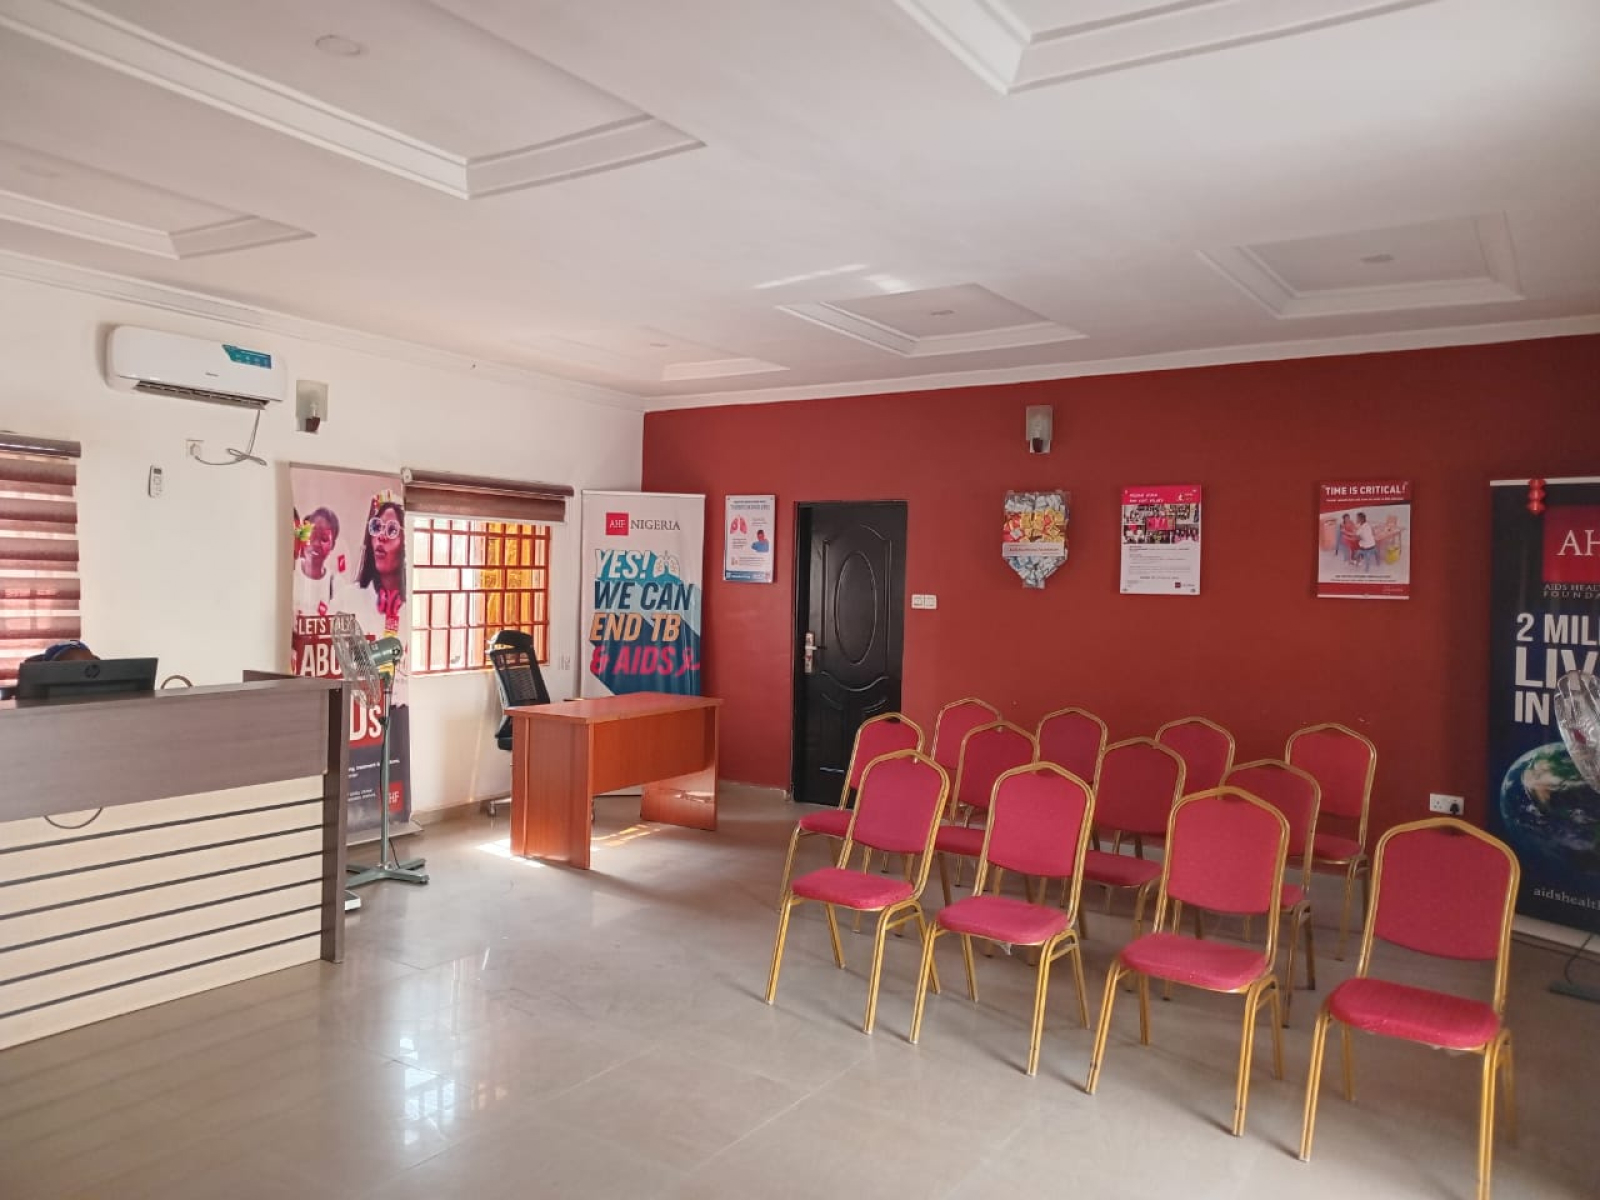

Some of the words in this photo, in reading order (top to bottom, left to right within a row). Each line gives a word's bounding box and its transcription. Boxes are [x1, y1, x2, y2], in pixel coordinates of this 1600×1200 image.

[1350, 486, 1358, 494] IS
[609, 519, 626, 528] AHF
[630, 519, 681, 531] NIGERIA
[1556, 529, 1600, 556] AH
[595, 549, 651, 579] YES!
[594, 580, 636, 610] WE
[640, 582, 694, 611] CAN
[1544, 583, 1567, 591] AIDS
[1571, 584, 1600, 592] HEAL
[590, 612, 643, 641] END
[651, 615, 683, 642] TB
[1516, 612, 1534, 641] 2
[1544, 613, 1600, 645] MIL
[590, 646, 610, 675] &
[613, 646, 677, 675] AIDS
[1515, 646, 1600, 690] LIV
[350, 690, 381, 740] Ds
[1515, 690, 1550, 725] IN
